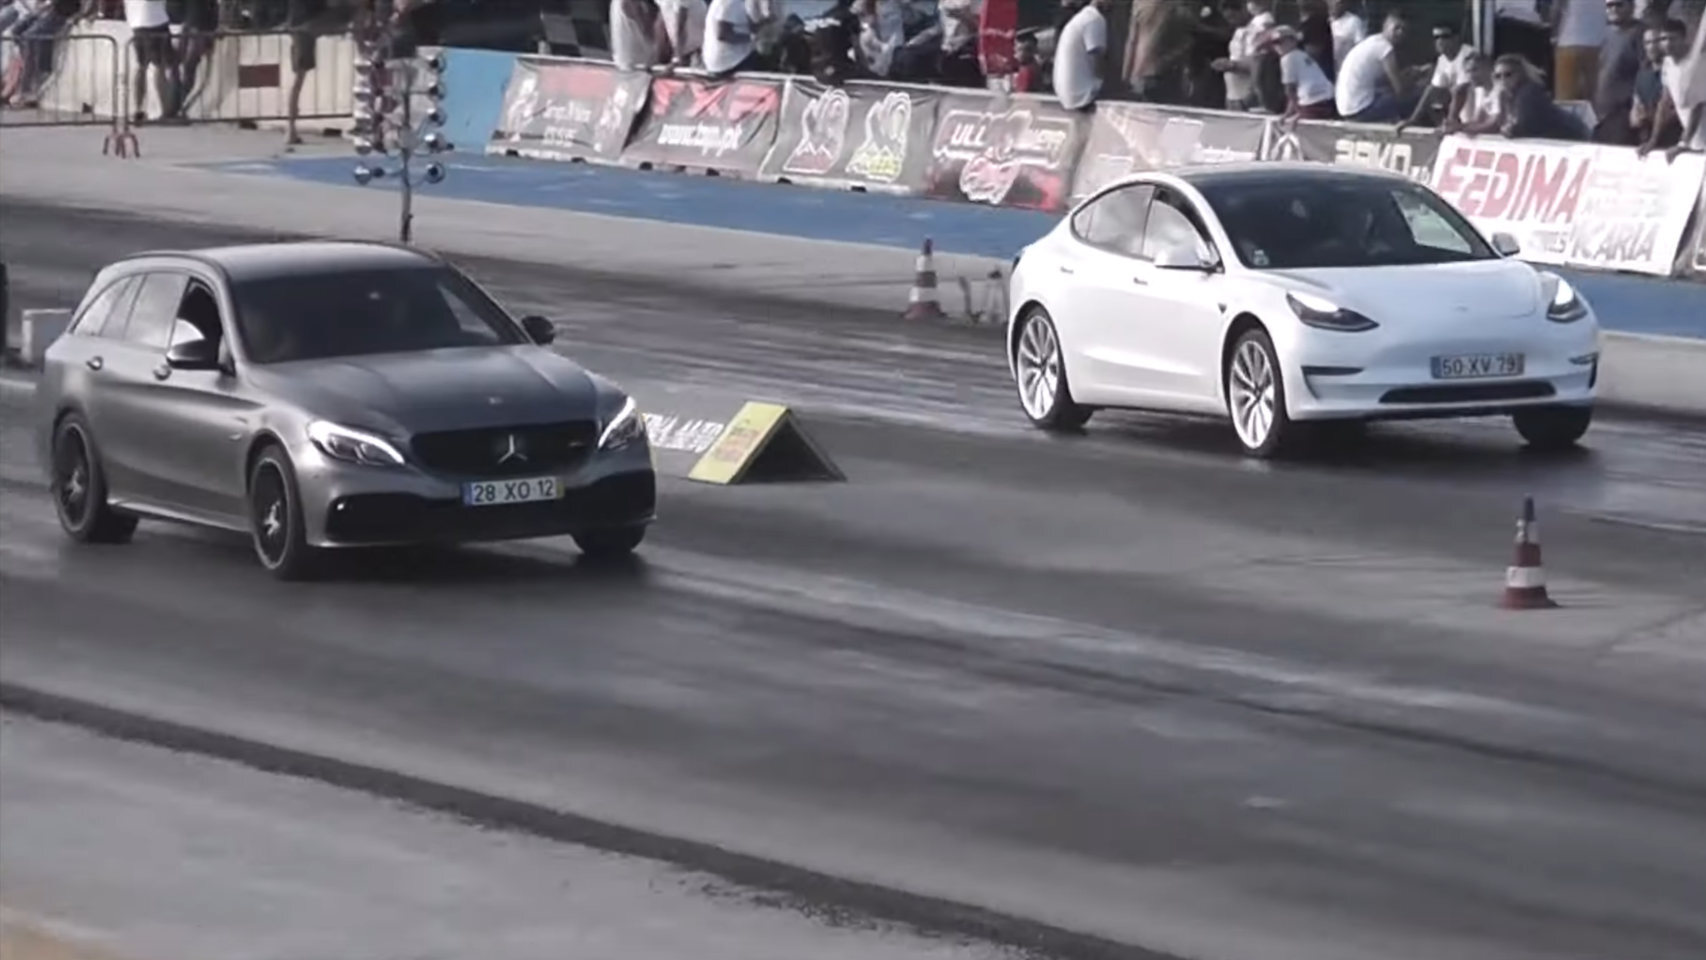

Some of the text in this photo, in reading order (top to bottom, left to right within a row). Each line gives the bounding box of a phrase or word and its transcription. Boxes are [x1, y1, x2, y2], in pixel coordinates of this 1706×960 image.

[1468, 356, 1492, 375] XV
[473, 479, 554, 502] 28 XO 12
